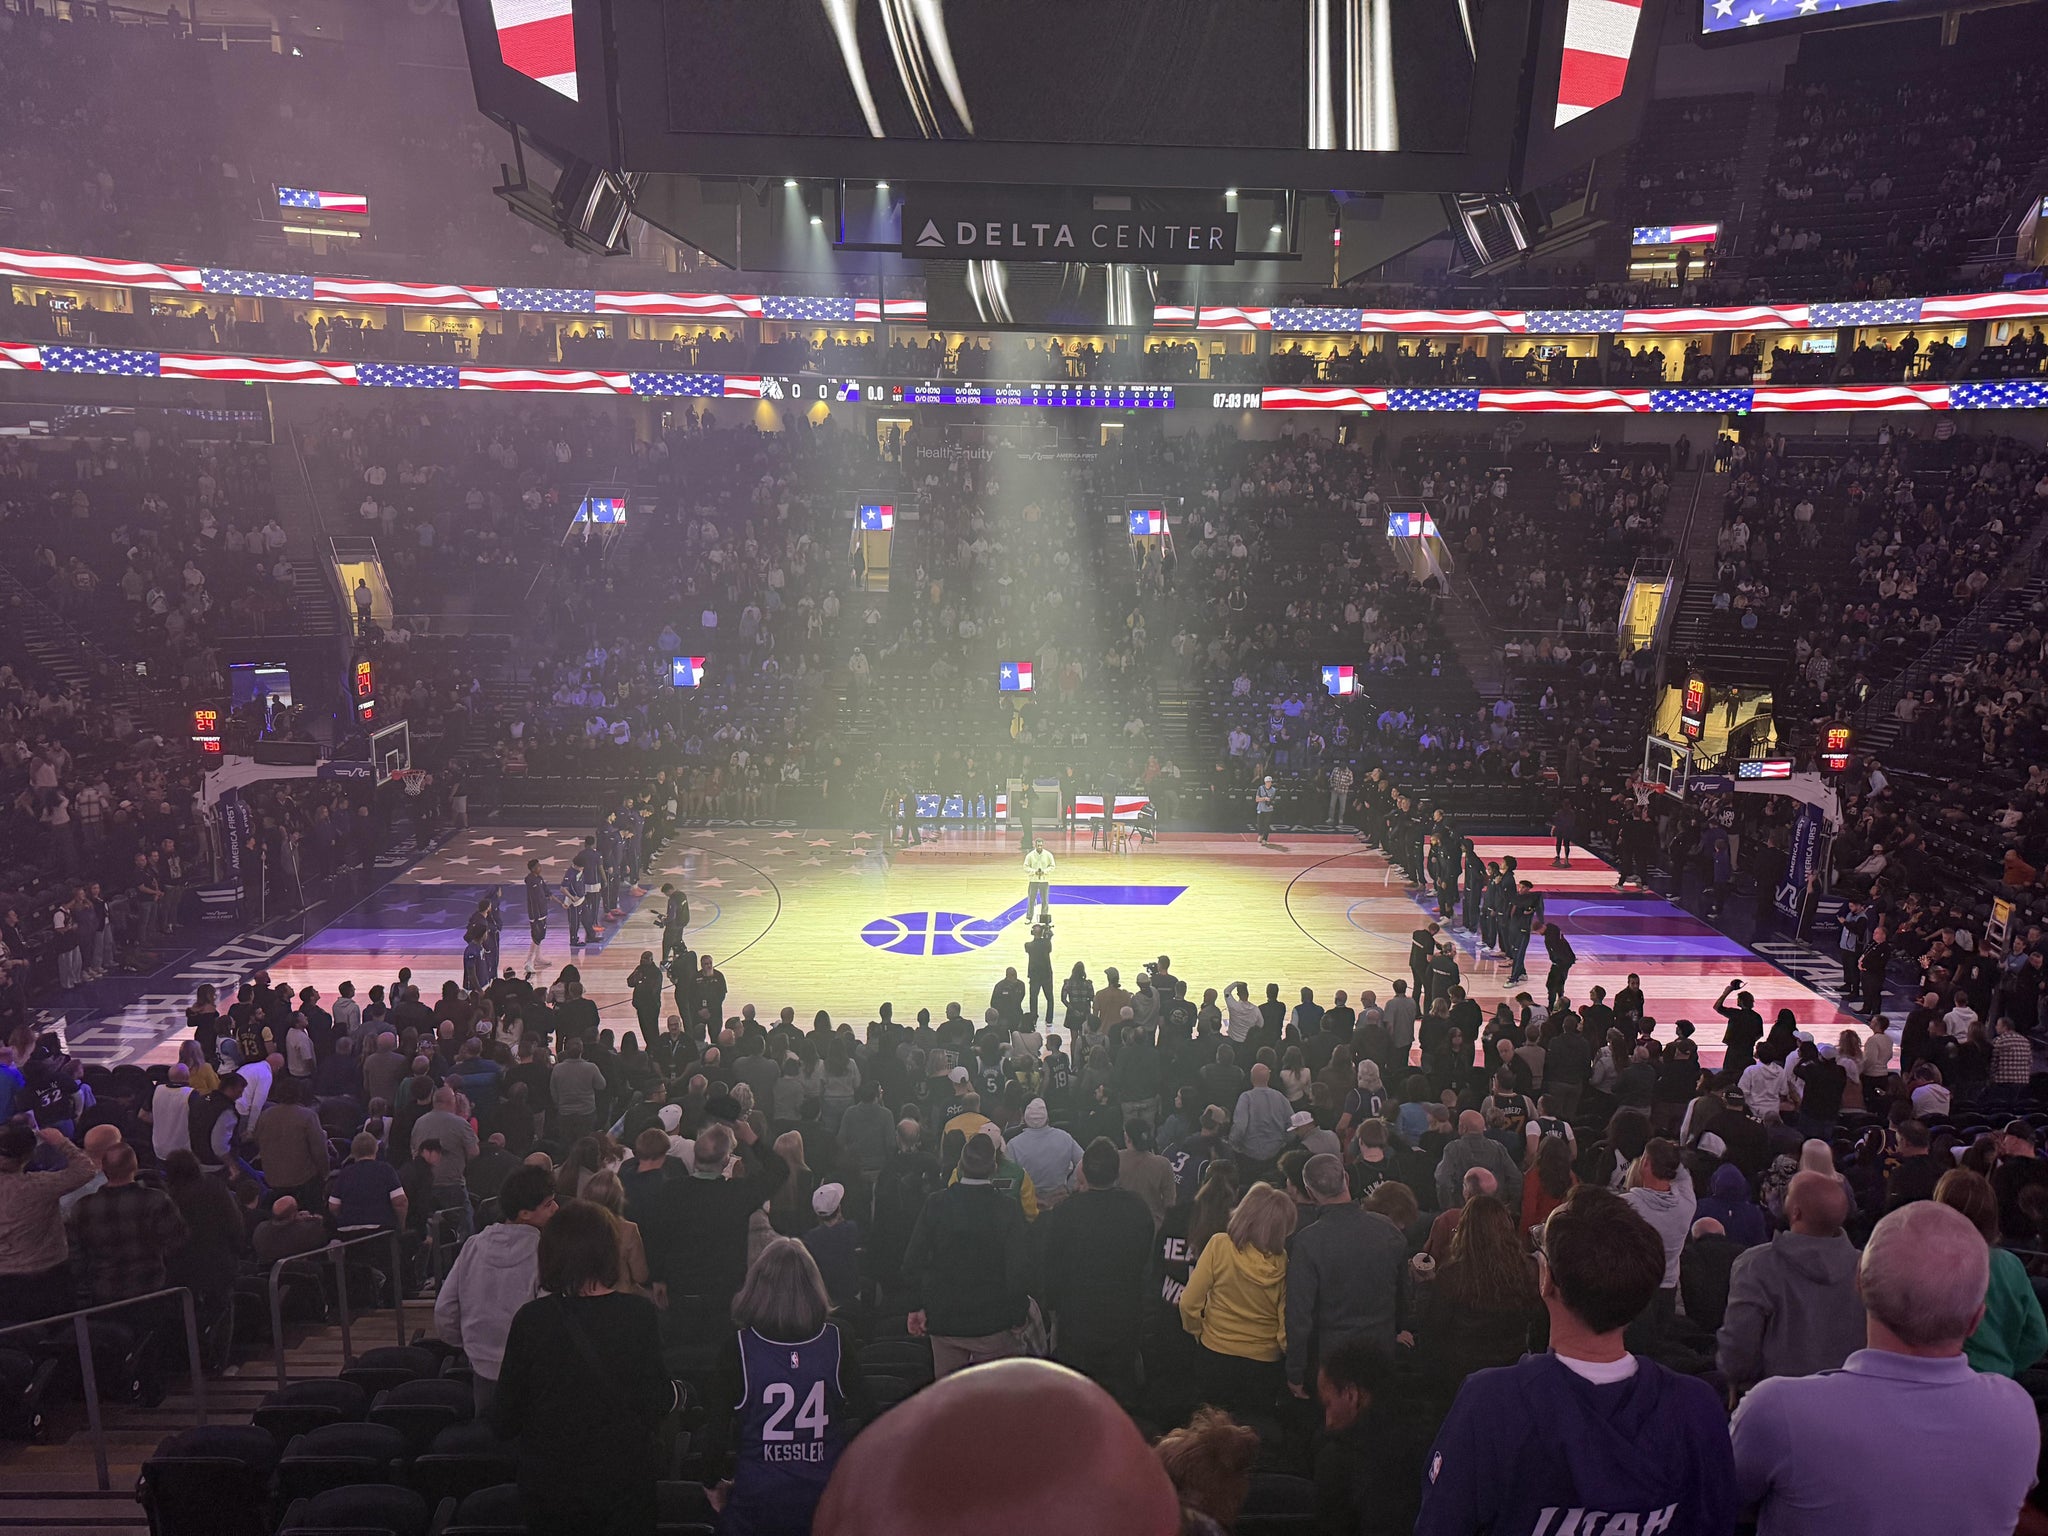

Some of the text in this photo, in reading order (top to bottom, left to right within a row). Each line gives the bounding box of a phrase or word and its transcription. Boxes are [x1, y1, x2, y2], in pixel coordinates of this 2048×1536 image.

[957, 222, 1224, 250] DELTA CENTER
[792, 383, 801, 398] 0
[819, 384, 828, 399] 0
[867, 386, 884, 401] 0.0
[1213, 393, 1260, 408] 07:03 PM
[357, 674, 371, 696] 24
[1686, 690, 1700, 712] 24
[195, 711, 217, 720] 12:00
[197, 720, 214, 731] 24
[1828, 729, 1848, 738] 12:00
[204, 742, 220, 751] 1:30
[1828, 738, 1843, 748] 24
[1830, 759, 1845, 768] 1:30
[705, 819, 798, 827] PACS
[1269, 824, 1360, 832] PACS
[226, 804, 240, 869] AMERICA FIRST
[1808, 821, 1818, 845] FIRST
[1788, 818, 1806, 879] AMERICA FIRST
[67, 993, 193, 1066] UTAH
[172, 933, 304, 988] JAZZ
[242, 1039, 259, 1056] 13
[986, 1078, 998, 1093] 5
[1054, 1070, 1067, 1089] 19
[41, 1089, 62, 1107] 32
[762, 1380, 829, 1441] 24
[764, 1441, 824, 1463] KESSLER
[1530, 1502, 1680, 1536] UTAH
